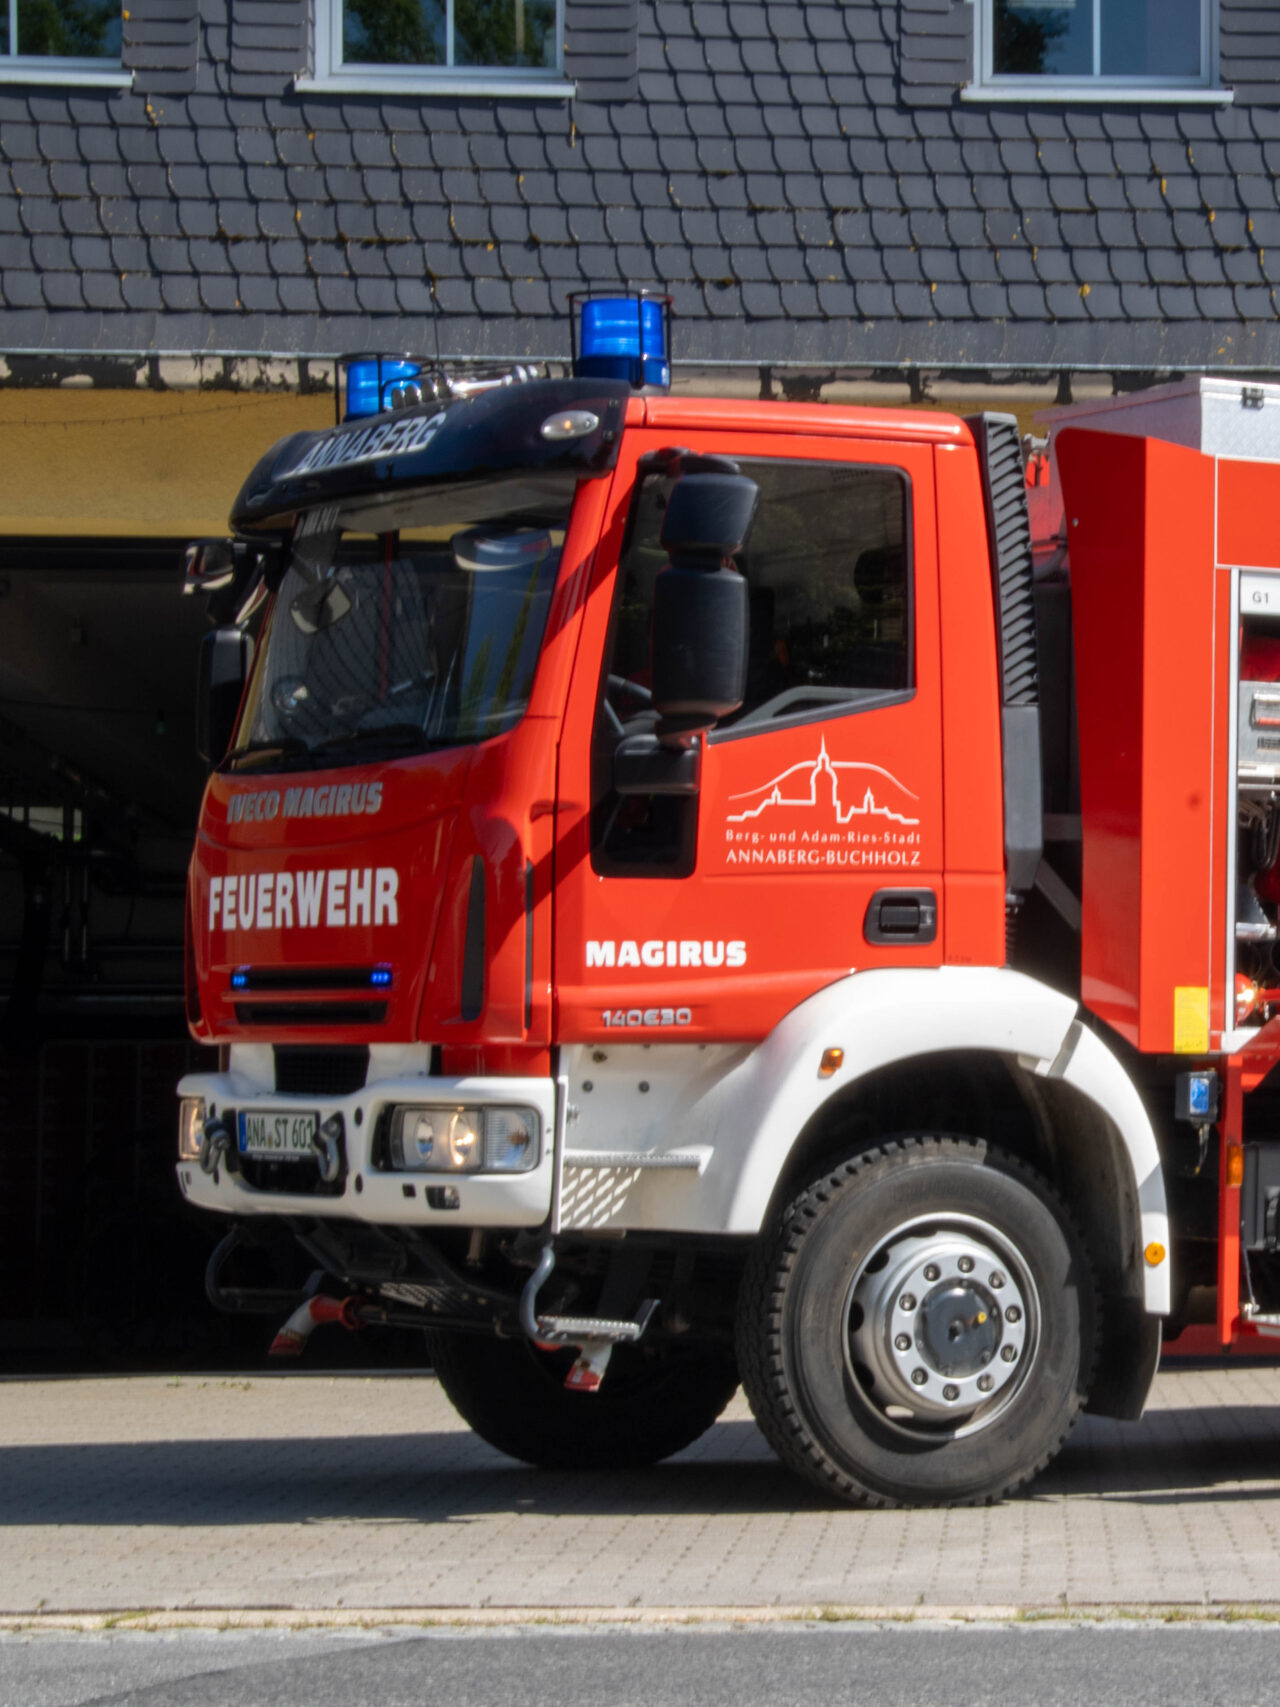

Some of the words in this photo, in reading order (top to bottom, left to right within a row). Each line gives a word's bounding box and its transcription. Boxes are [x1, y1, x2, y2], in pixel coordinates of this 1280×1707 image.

[289, 411, 447, 473] ANNABERG
[1252, 590, 1269, 605] G1
[227, 790, 280, 824] IVECO
[281, 782, 384, 819] MAGIRUS
[769, 830, 796, 842] und
[726, 849, 921, 867] ANNABERG-BUCHHOLZ
[208, 866, 399, 931] FEUERWEHR
[585, 940, 747, 968] MAGIRUS
[246, 1117, 266, 1147] ANA
[274, 1117, 289, 1148] ST
